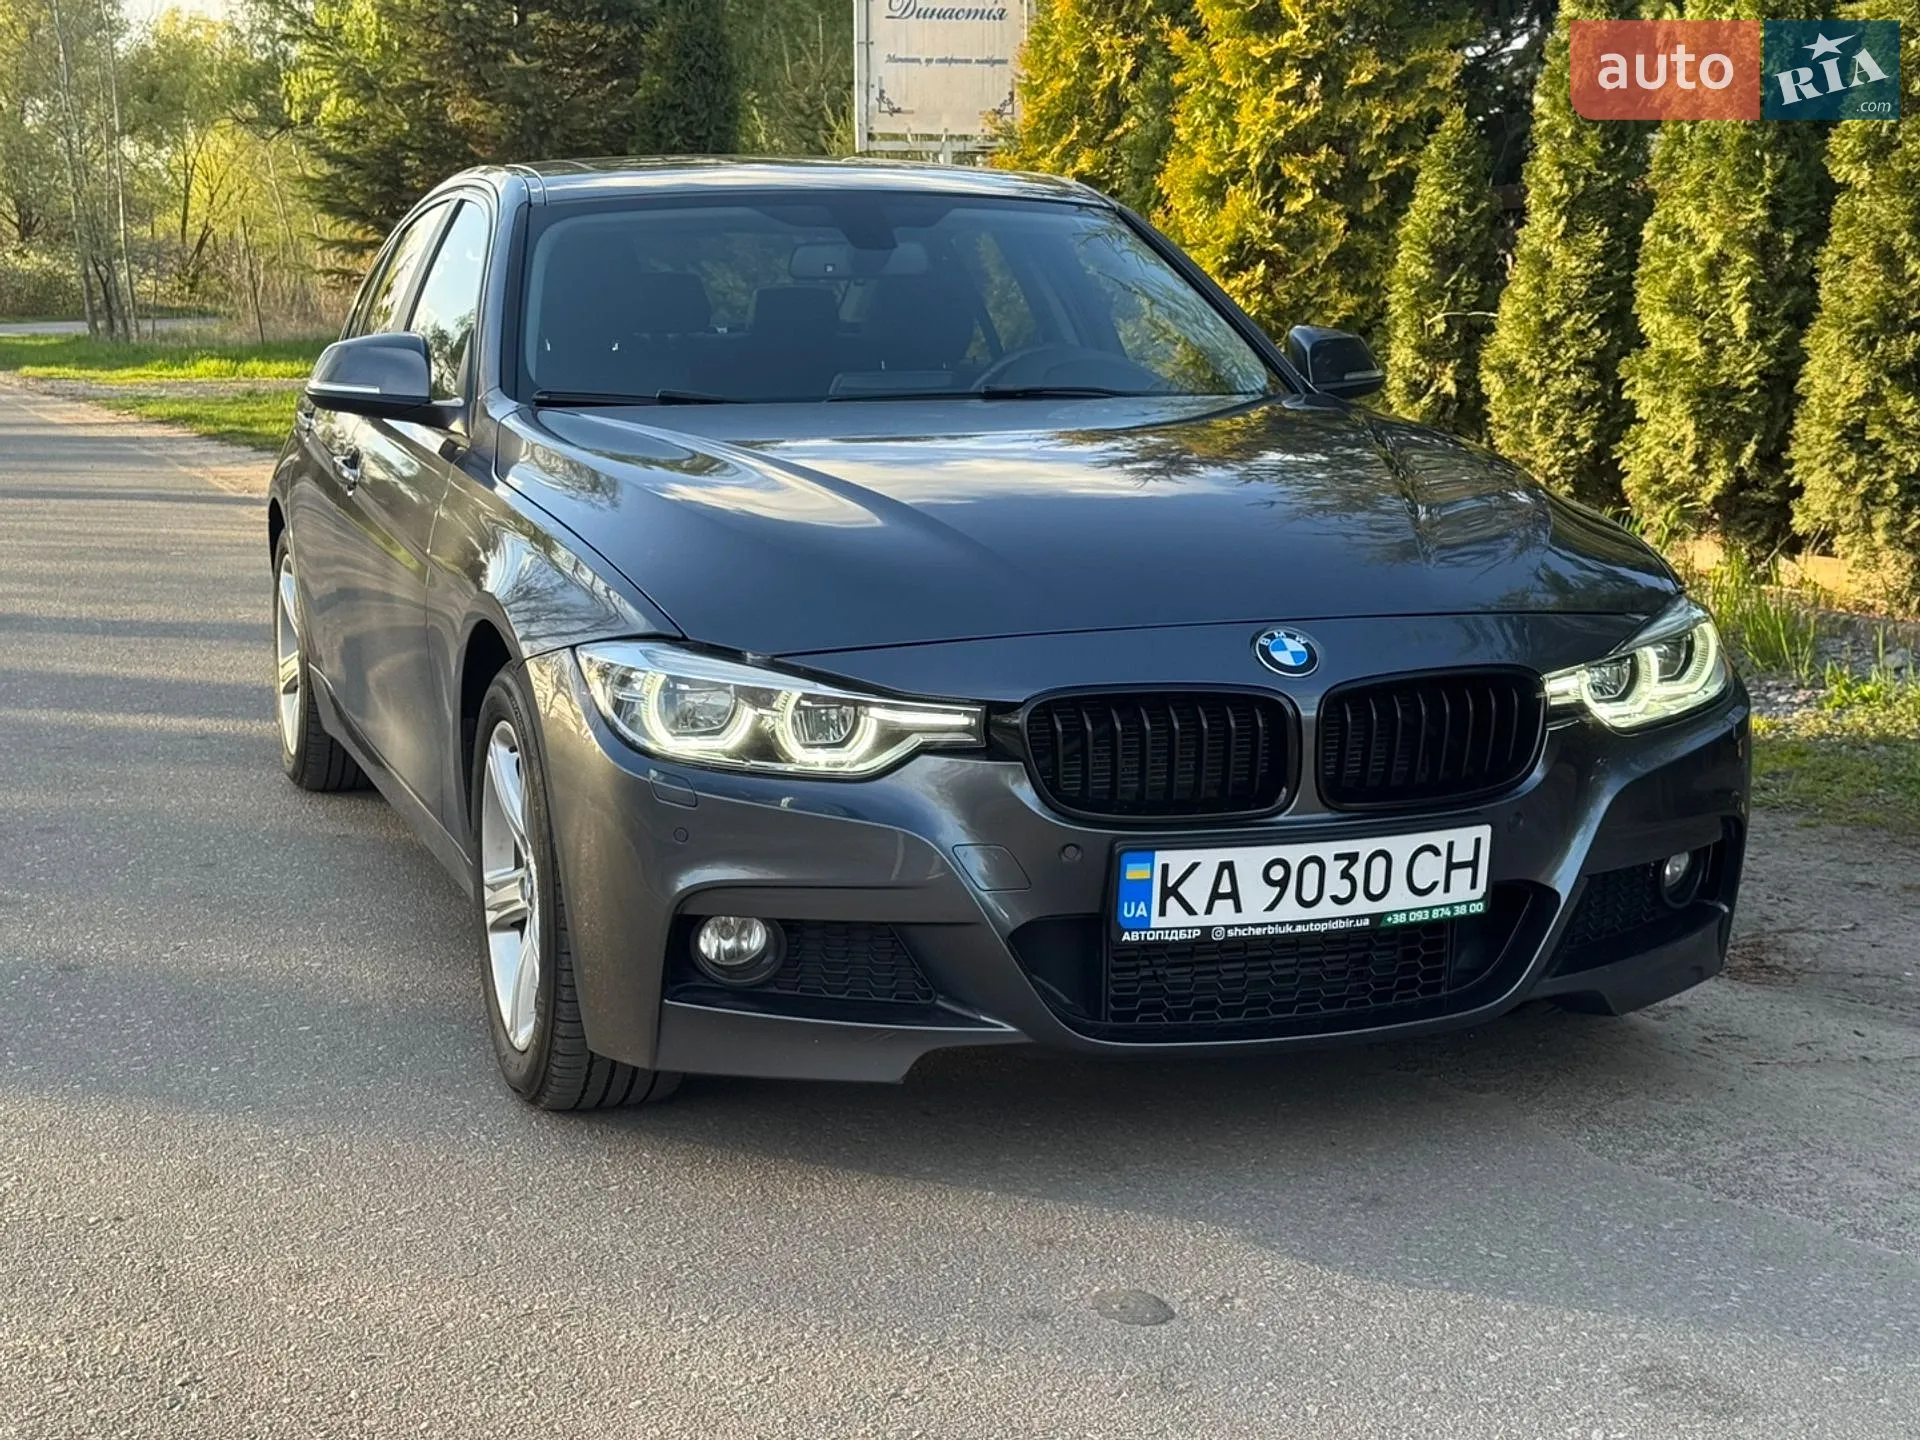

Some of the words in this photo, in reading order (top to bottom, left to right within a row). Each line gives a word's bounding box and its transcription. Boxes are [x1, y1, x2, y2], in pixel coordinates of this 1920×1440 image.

[885, 0, 1008, 21] Династія
[1259, 631, 1309, 647] BMW
[1158, 861, 1243, 917] KA
[1261, 849, 1393, 913] 9030
[1405, 837, 1482, 898] CH
[1123, 901, 1148, 918] UA
[1386, 912, 1408, 925] +38
[1408, 910, 1430, 922] 093
[1431, 907, 1452, 919] 874
[1453, 905, 1467, 916] 38
[1469, 902, 1484, 913] 00
[1121, 928, 1202, 942] АВТОПІДБІР
